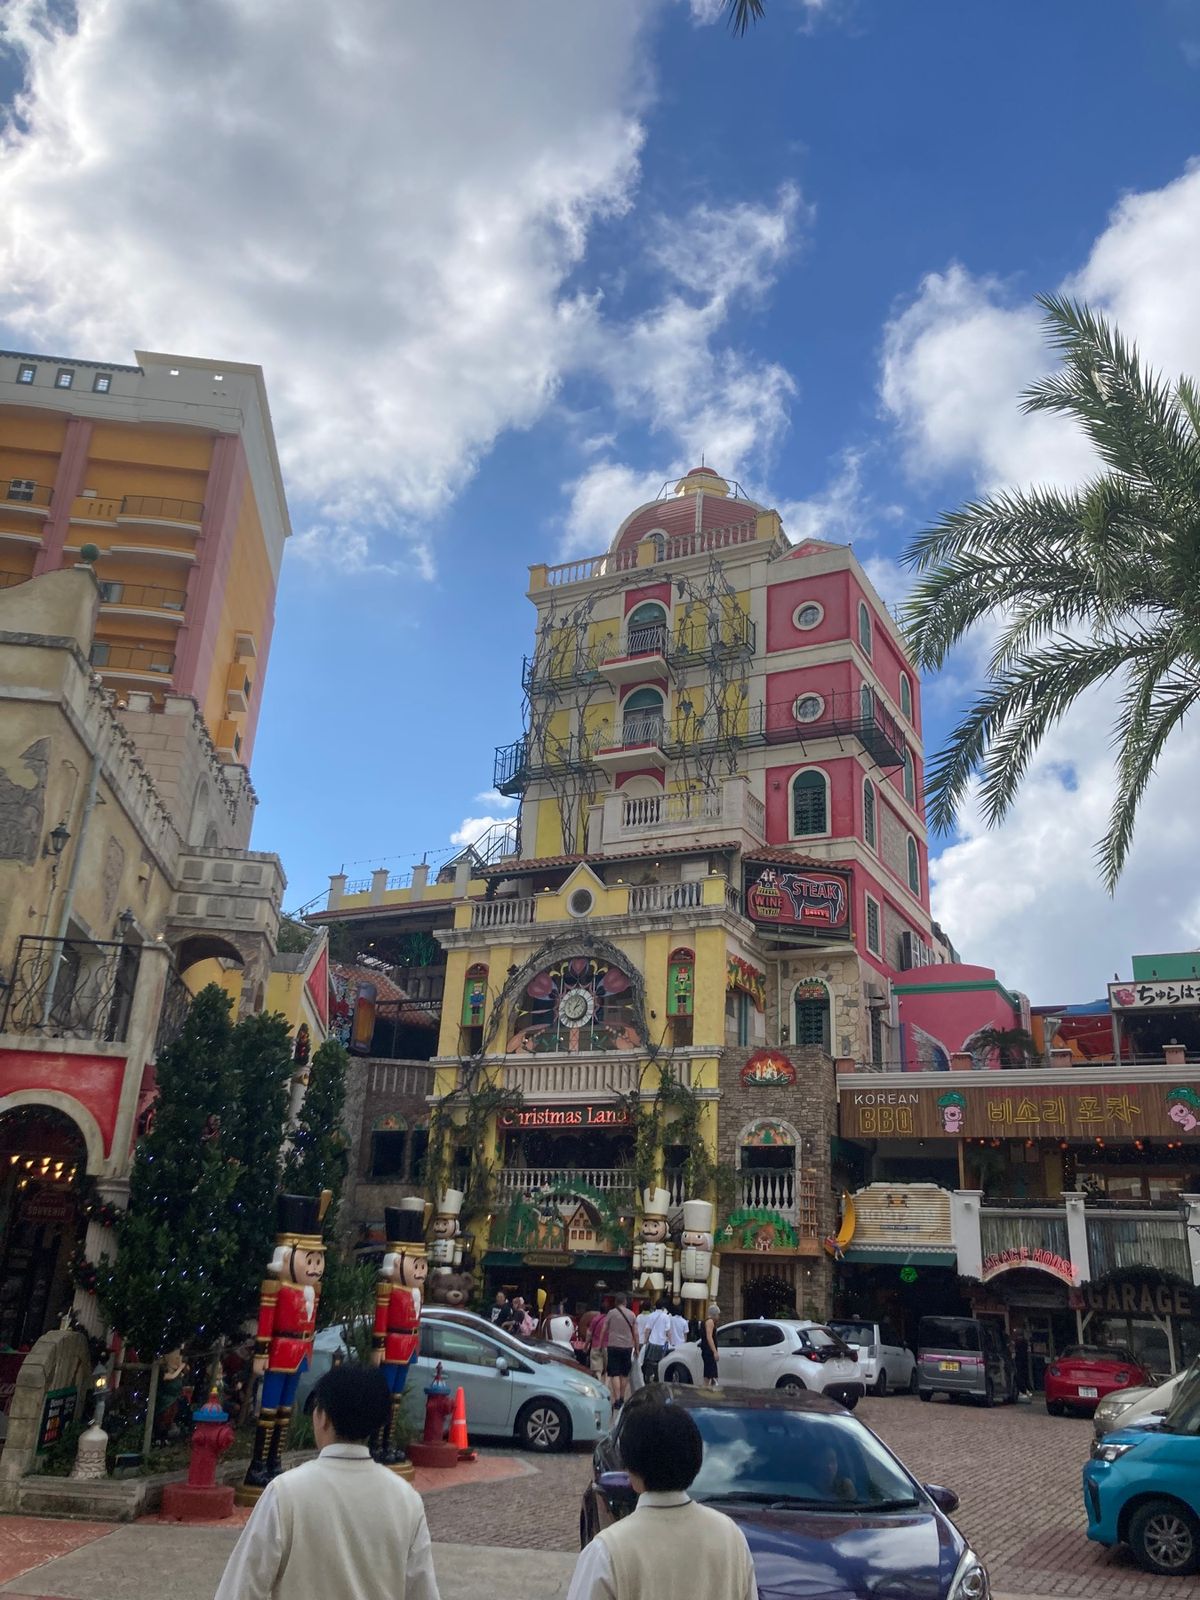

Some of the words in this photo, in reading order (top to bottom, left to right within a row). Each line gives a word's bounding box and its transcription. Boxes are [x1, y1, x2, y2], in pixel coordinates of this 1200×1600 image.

[760, 870, 776, 881] 4F
[792, 881, 838, 900] STEAK
[754, 895, 783, 908] WINE
[854, 1092, 919, 1105] KOREAN
[587, 1106, 627, 1124] Land
[987, 1096, 1066, 1125] 비소리
[1076, 1094, 1141, 1125] 포차
[859, 1106, 914, 1134] BBQ
[1087, 1282, 1192, 1315] GARAGE
